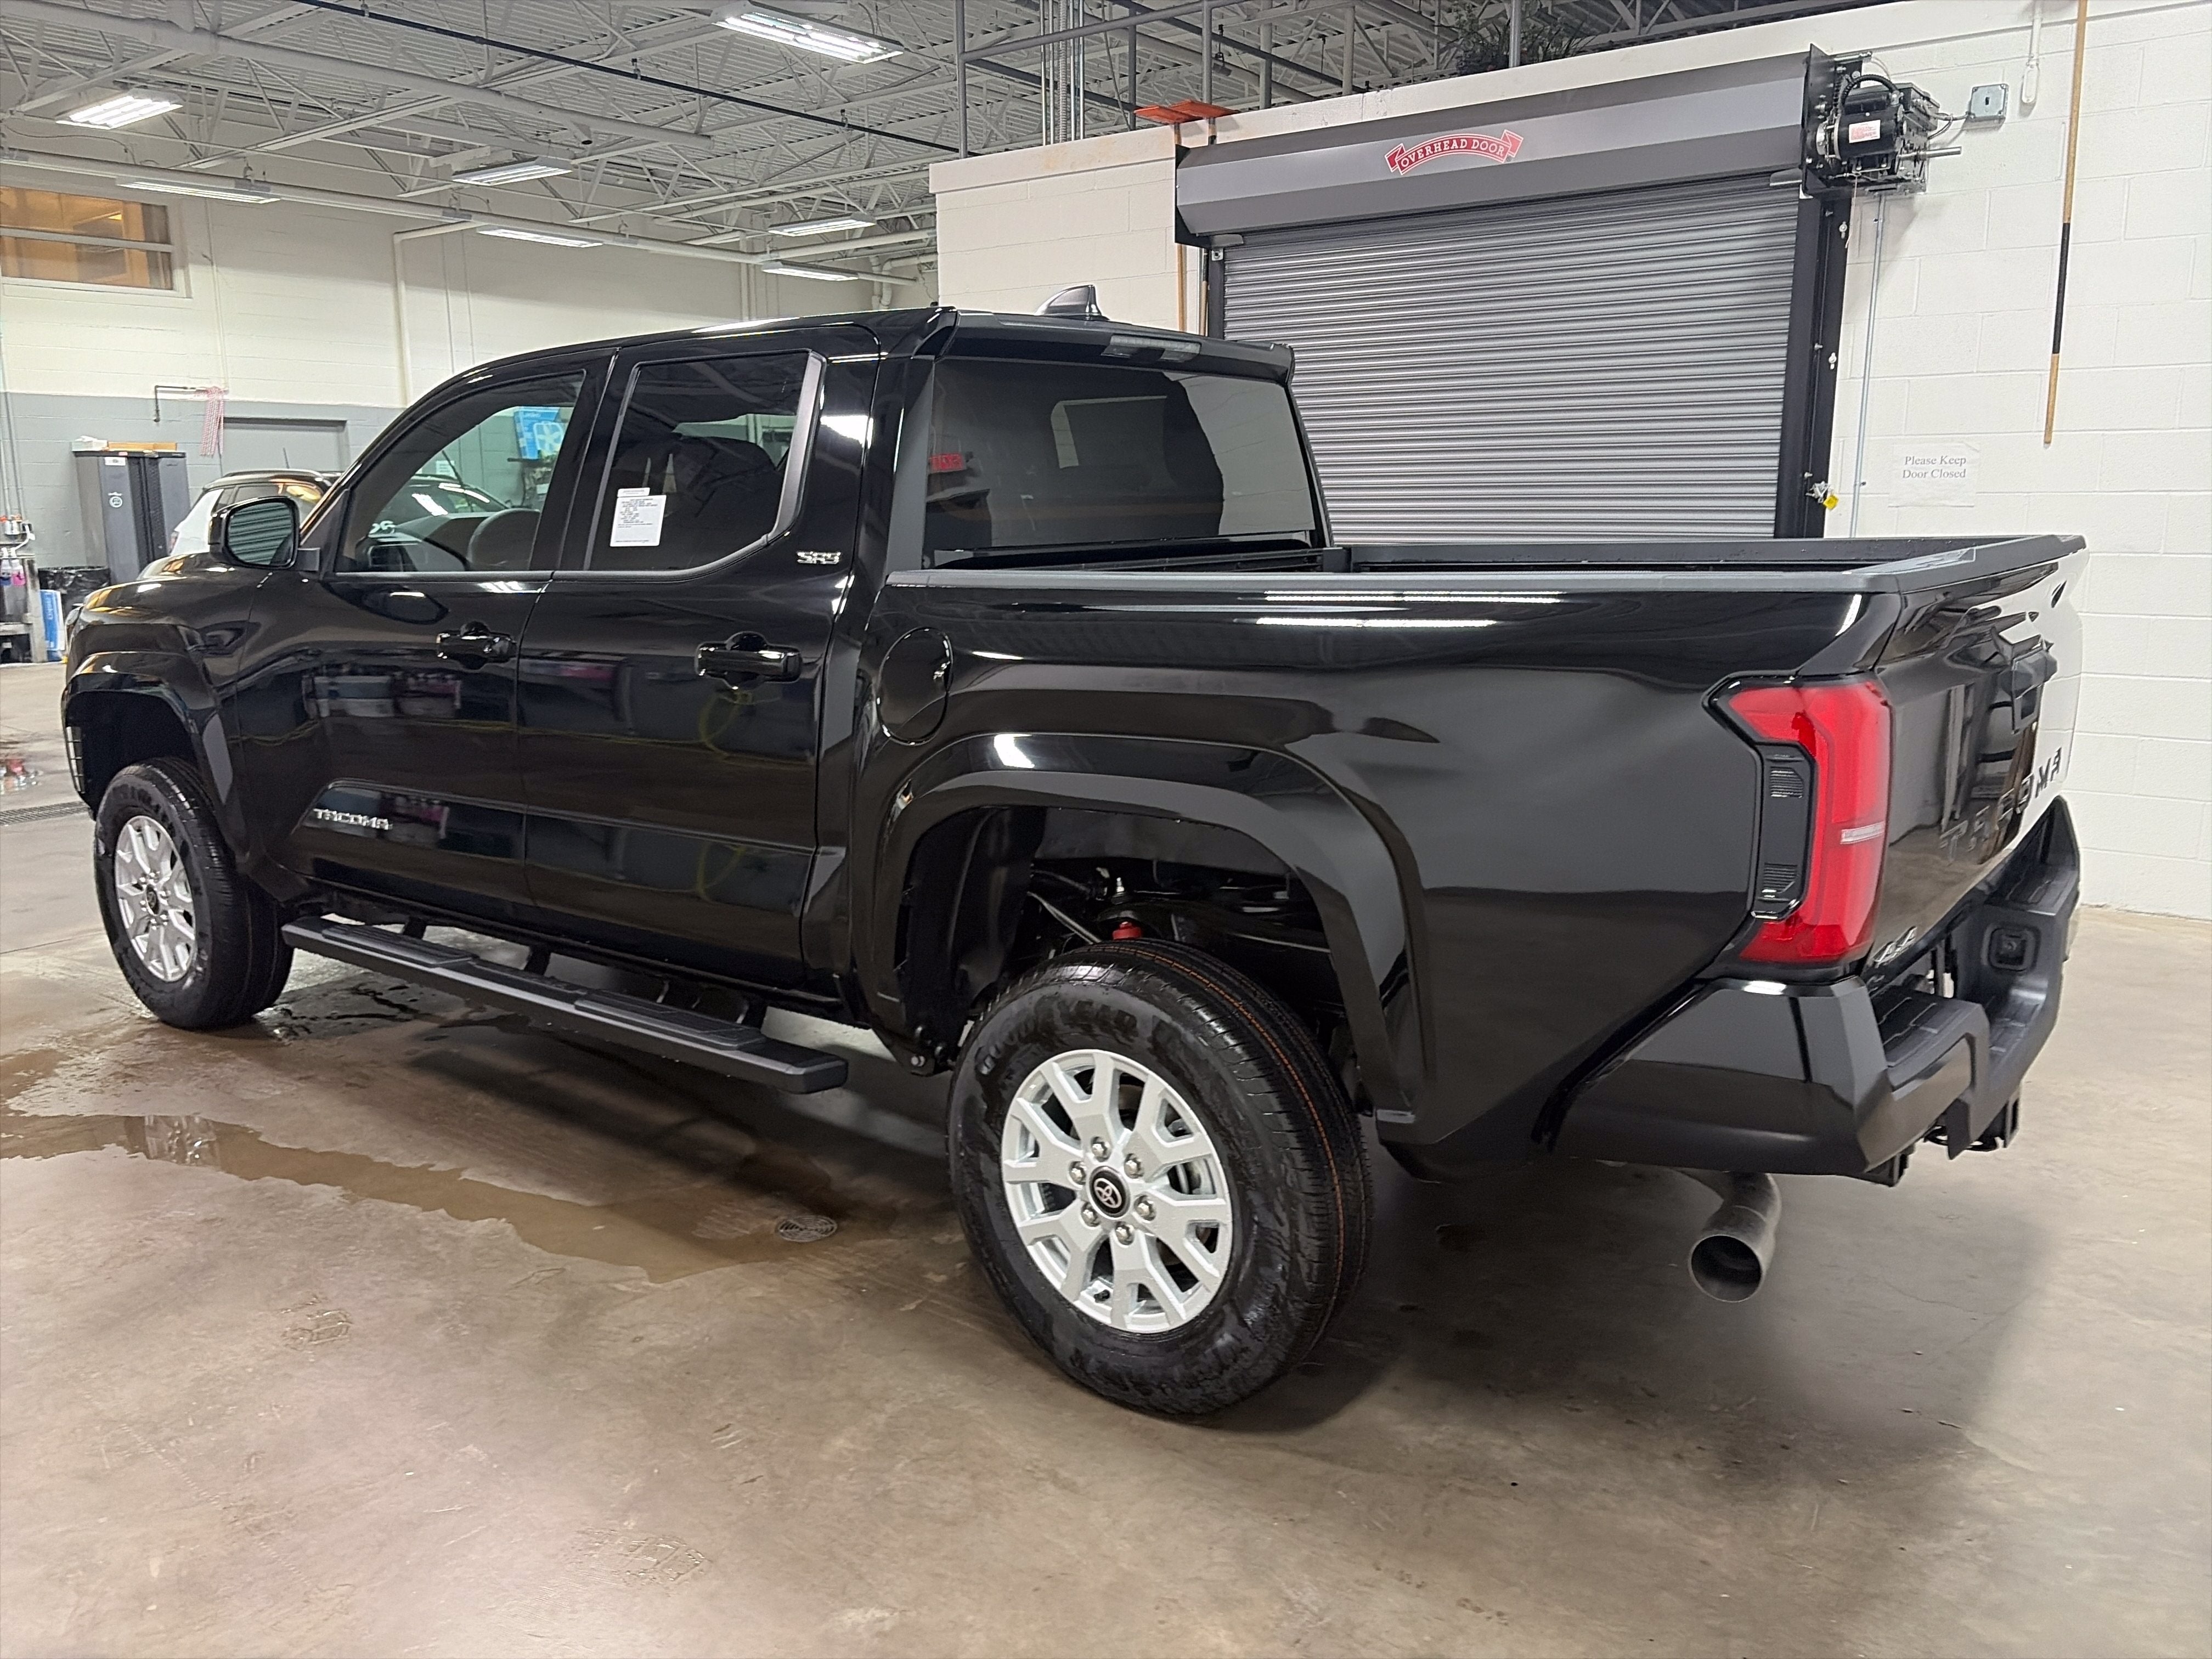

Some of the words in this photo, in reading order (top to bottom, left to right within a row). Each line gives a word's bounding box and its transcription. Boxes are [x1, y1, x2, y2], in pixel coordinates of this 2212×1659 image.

[1401, 139, 1468, 167] OVERHEAD
[1471, 139, 1505, 157] DOOR
[1905, 456, 1937, 465] Please
[1939, 455, 1967, 467] Keep
[1902, 470, 1928, 478] Door
[1931, 469, 1966, 478] Closed
[797, 551, 841, 564] SR5
[313, 808, 393, 830] TACOMA
